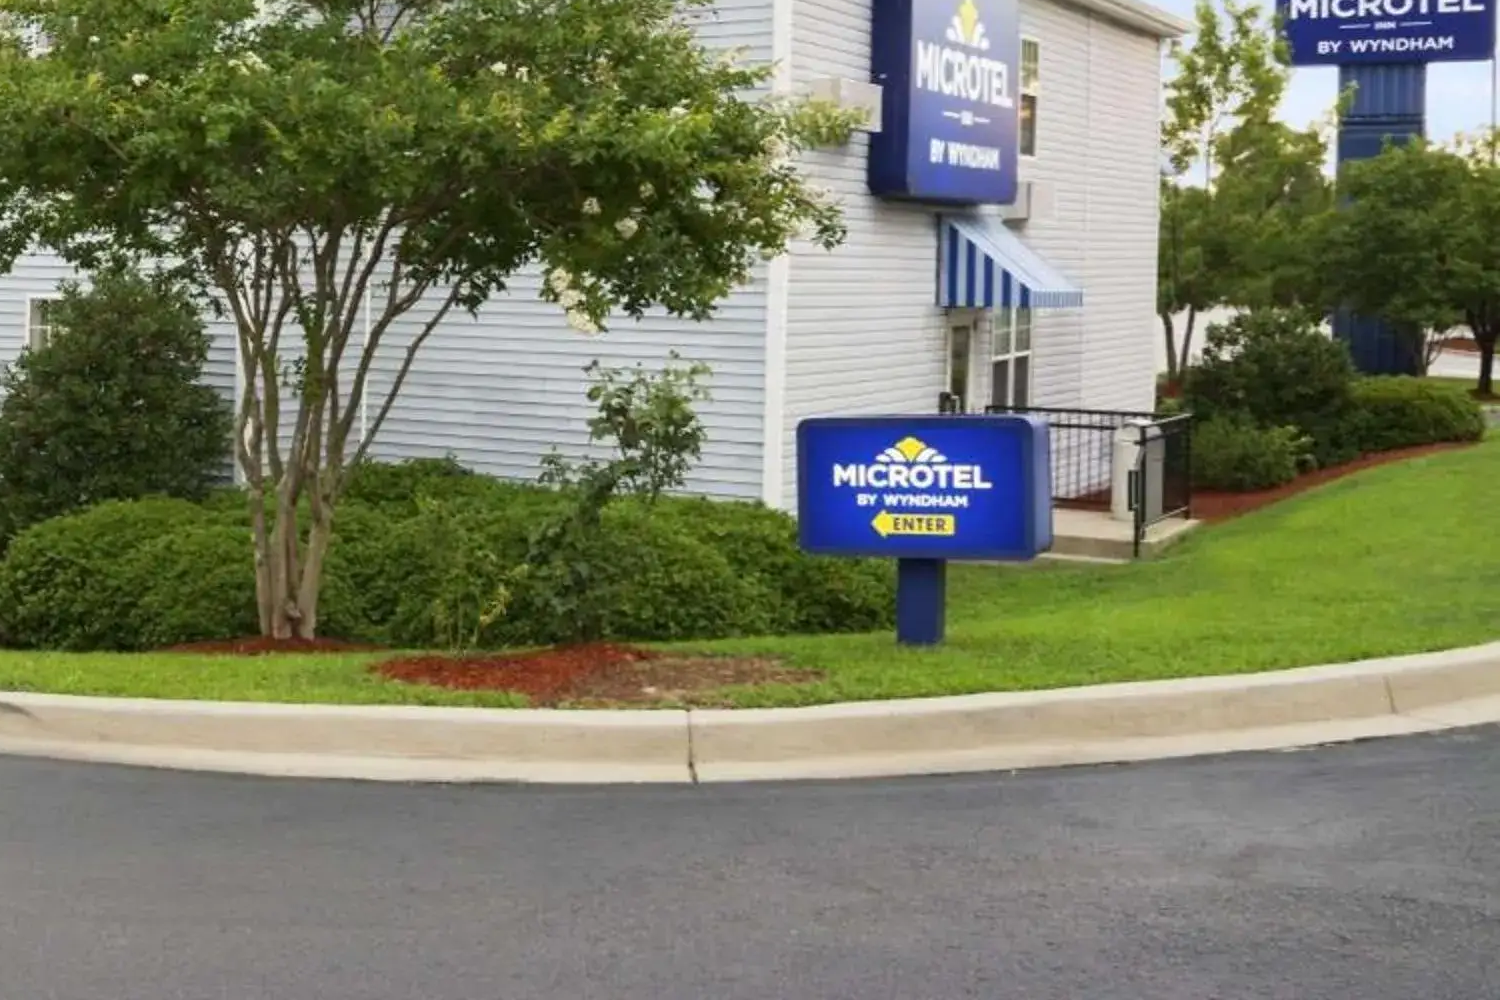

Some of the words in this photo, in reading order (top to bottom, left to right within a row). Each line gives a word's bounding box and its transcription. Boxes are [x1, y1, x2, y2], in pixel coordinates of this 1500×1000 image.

[1317, 40, 1342, 54] BY
[1349, 36, 1454, 54] WYNDHAM
[916, 40, 1013, 108] MICROTEL
[930, 138, 945, 163] BY
[947, 141, 1000, 171] WYNDHAM
[832, 463, 993, 489] MICROTEL
[856, 493, 878, 506] BY
[882, 493, 969, 508] WYNDHAM
[893, 517, 947, 531] ENTER
